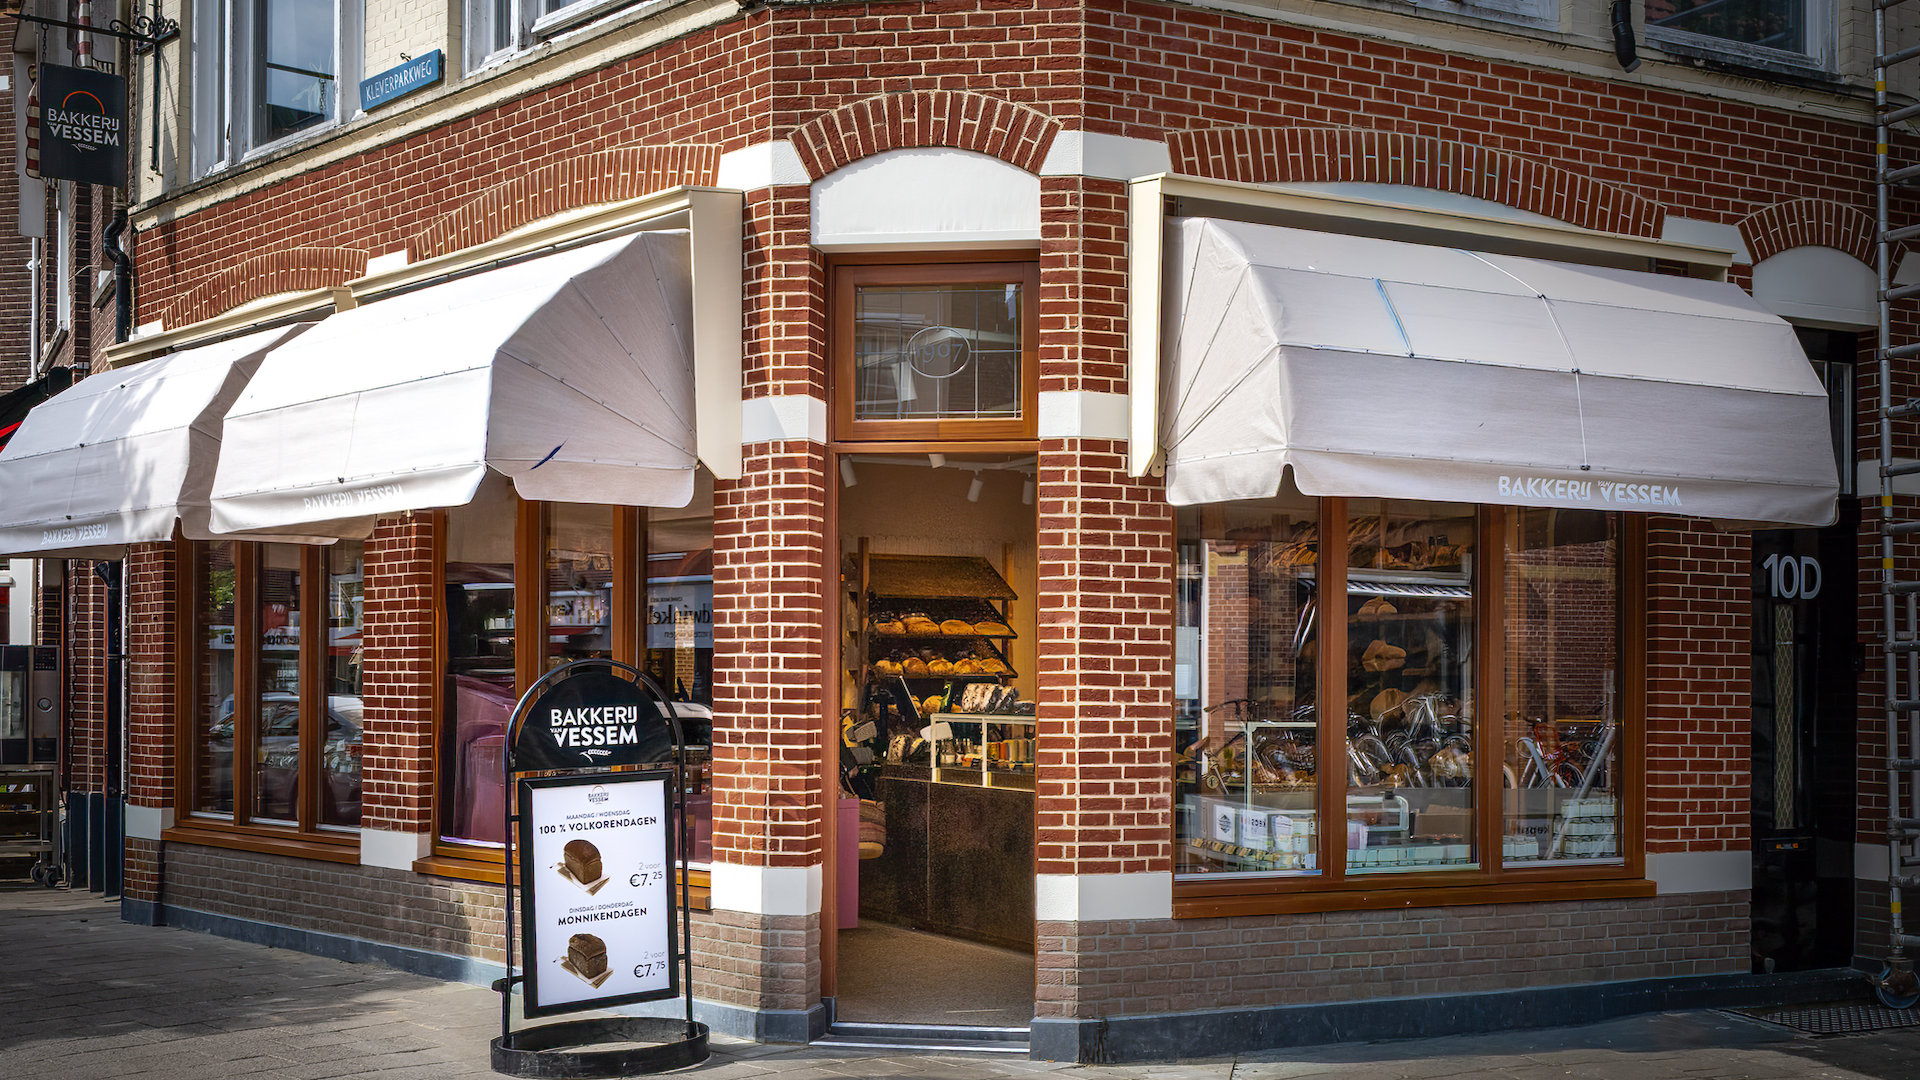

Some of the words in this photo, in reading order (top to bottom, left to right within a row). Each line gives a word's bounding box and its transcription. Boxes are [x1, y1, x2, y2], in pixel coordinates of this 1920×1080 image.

[365, 59, 432, 102] KLEVERPARKWEG
[47, 107, 120, 131] BAKKERIJ
[49, 123, 119, 146] VESSEM
[916, 343, 963, 363] 1907
[303, 491, 353, 512] BAKKERIJ
[1498, 476, 1591, 501] BAKKERIJ
[1600, 482, 1682, 506] VESSEM
[1763, 553, 1822, 600] 10D
[550, 705, 638, 727] BAKKERIJ
[553, 725, 639, 748] VESSEM
[566, 812, 595, 820] MAANDAG
[599, 809, 631, 818] WOENSDAG
[539, 825, 556, 835] 100
[559, 824, 566, 833] %
[568, 816, 657, 832] VOLKORENDAGEN
[638, 862, 644, 871] 2
[557, 907, 648, 926] MONNIKENDAGEN
[568, 905, 594, 914] DINSDAG
[598, 901, 634, 911] DONDERDAG
[644, 951, 649, 960] 2
[650, 951, 665, 959] voor
